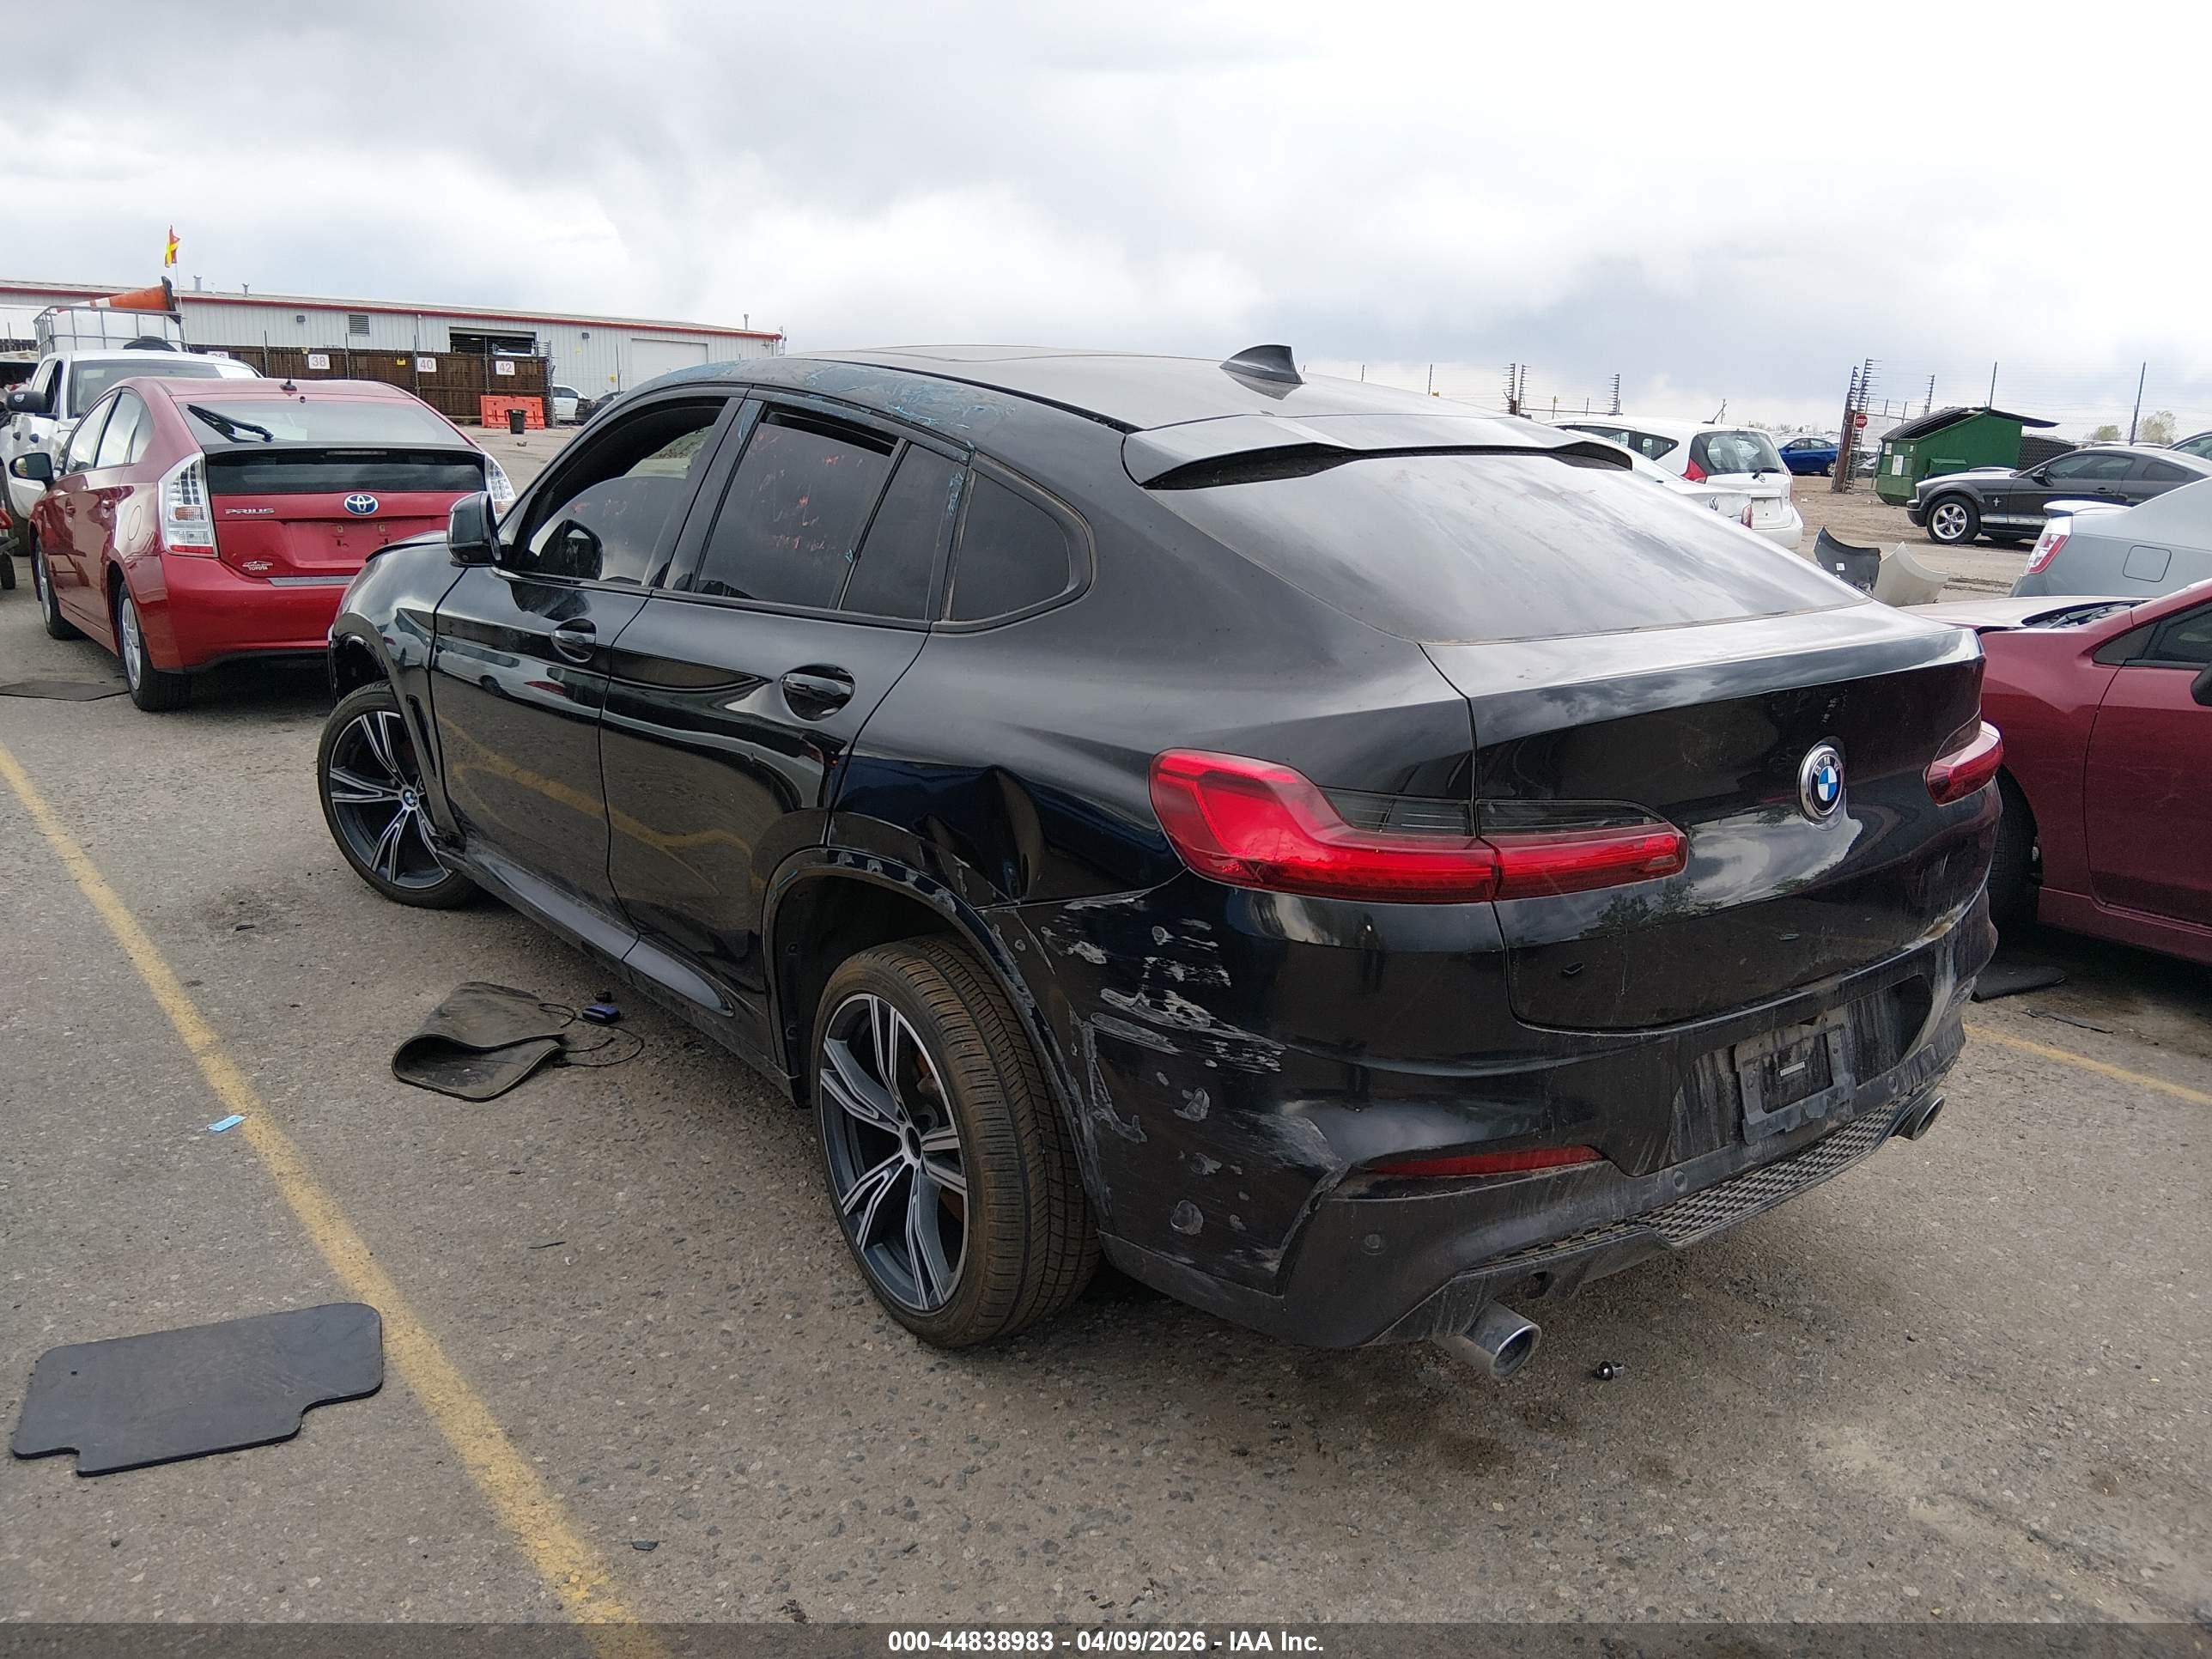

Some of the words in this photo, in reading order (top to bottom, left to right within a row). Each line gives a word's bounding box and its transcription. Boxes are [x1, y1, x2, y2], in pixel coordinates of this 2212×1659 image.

[312, 356, 326, 367] 38
[419, 359, 434, 370] 40
[500, 362, 513, 373] 42
[1814, 756, 1840, 777] BMW
